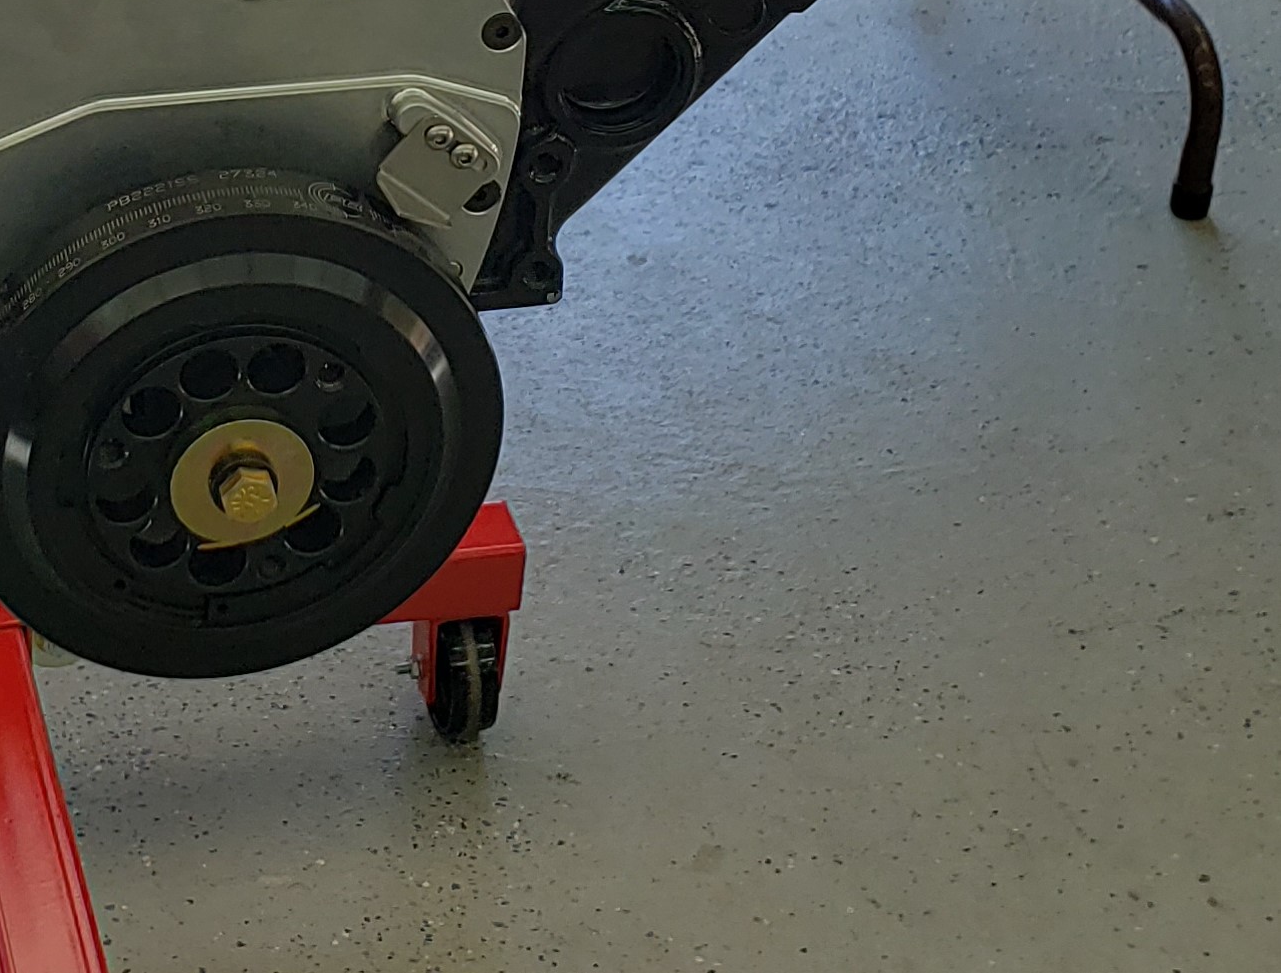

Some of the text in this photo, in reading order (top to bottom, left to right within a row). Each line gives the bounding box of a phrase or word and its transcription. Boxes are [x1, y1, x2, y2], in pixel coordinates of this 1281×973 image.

[195, 202, 222, 215] 320
[147, 214, 172, 229] 310
[100, 231, 126, 250] 300
[57, 257, 82, 278] 290
